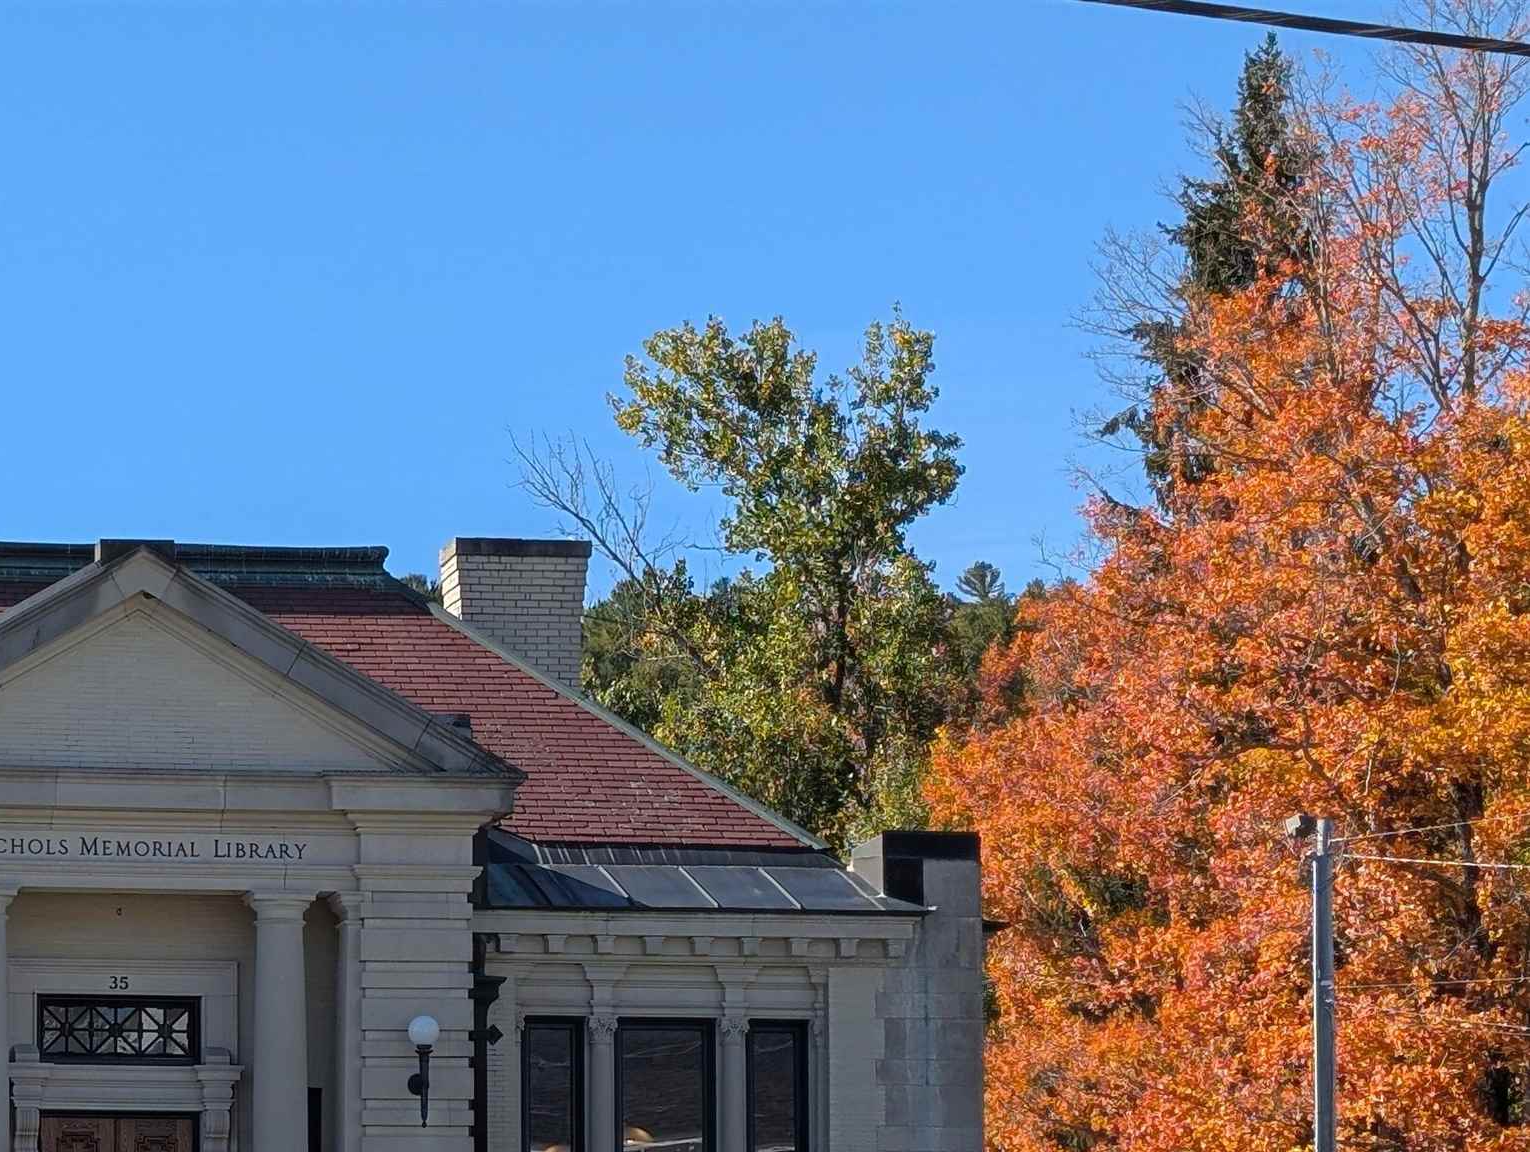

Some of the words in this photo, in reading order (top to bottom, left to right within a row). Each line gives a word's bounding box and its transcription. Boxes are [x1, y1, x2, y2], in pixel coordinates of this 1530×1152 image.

[79, 836, 200, 857] MEMORIAL
[213, 839, 307, 859] LIBRARY
[109, 976, 129, 990] 35
